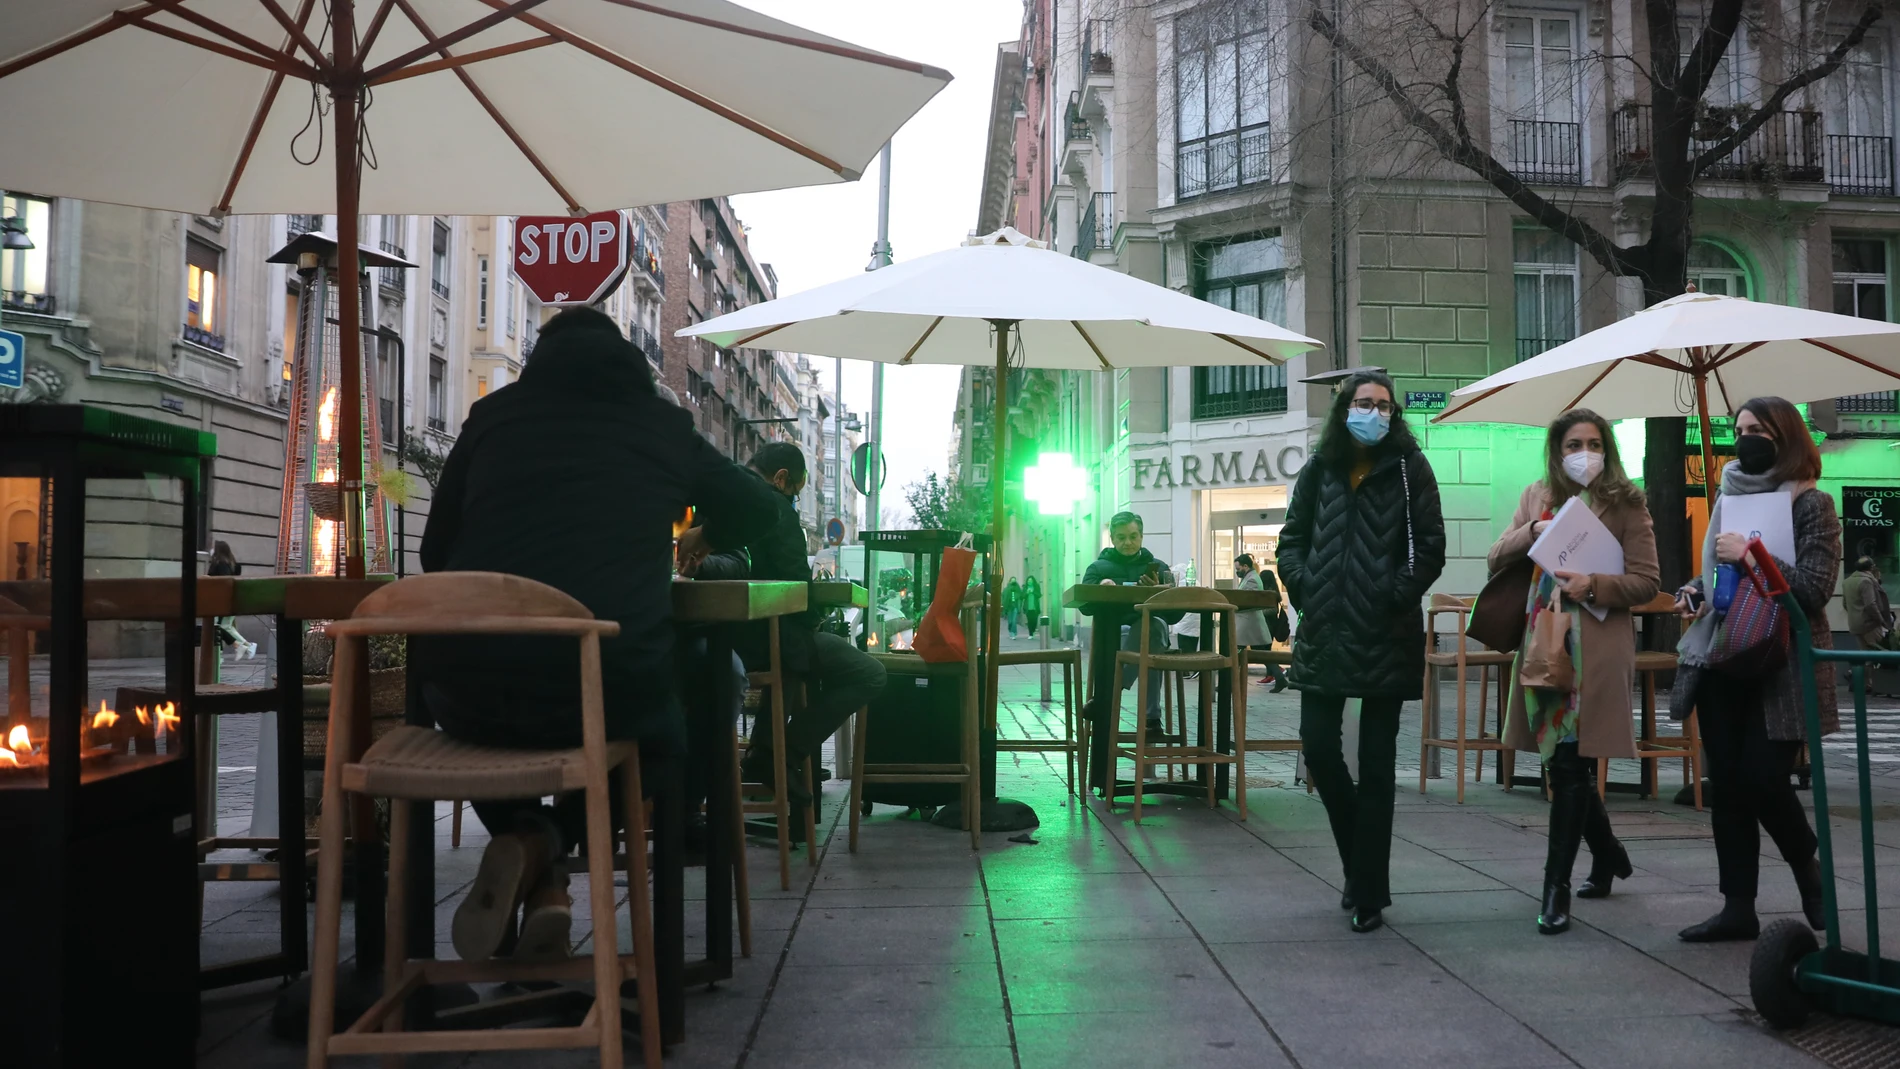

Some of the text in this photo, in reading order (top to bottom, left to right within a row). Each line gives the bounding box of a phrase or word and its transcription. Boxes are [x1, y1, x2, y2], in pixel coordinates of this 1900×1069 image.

[518, 221, 616, 266] STOP
[1407, 400, 1428, 408] JORGE
[1853, 518, 1894, 527] TAPAS
